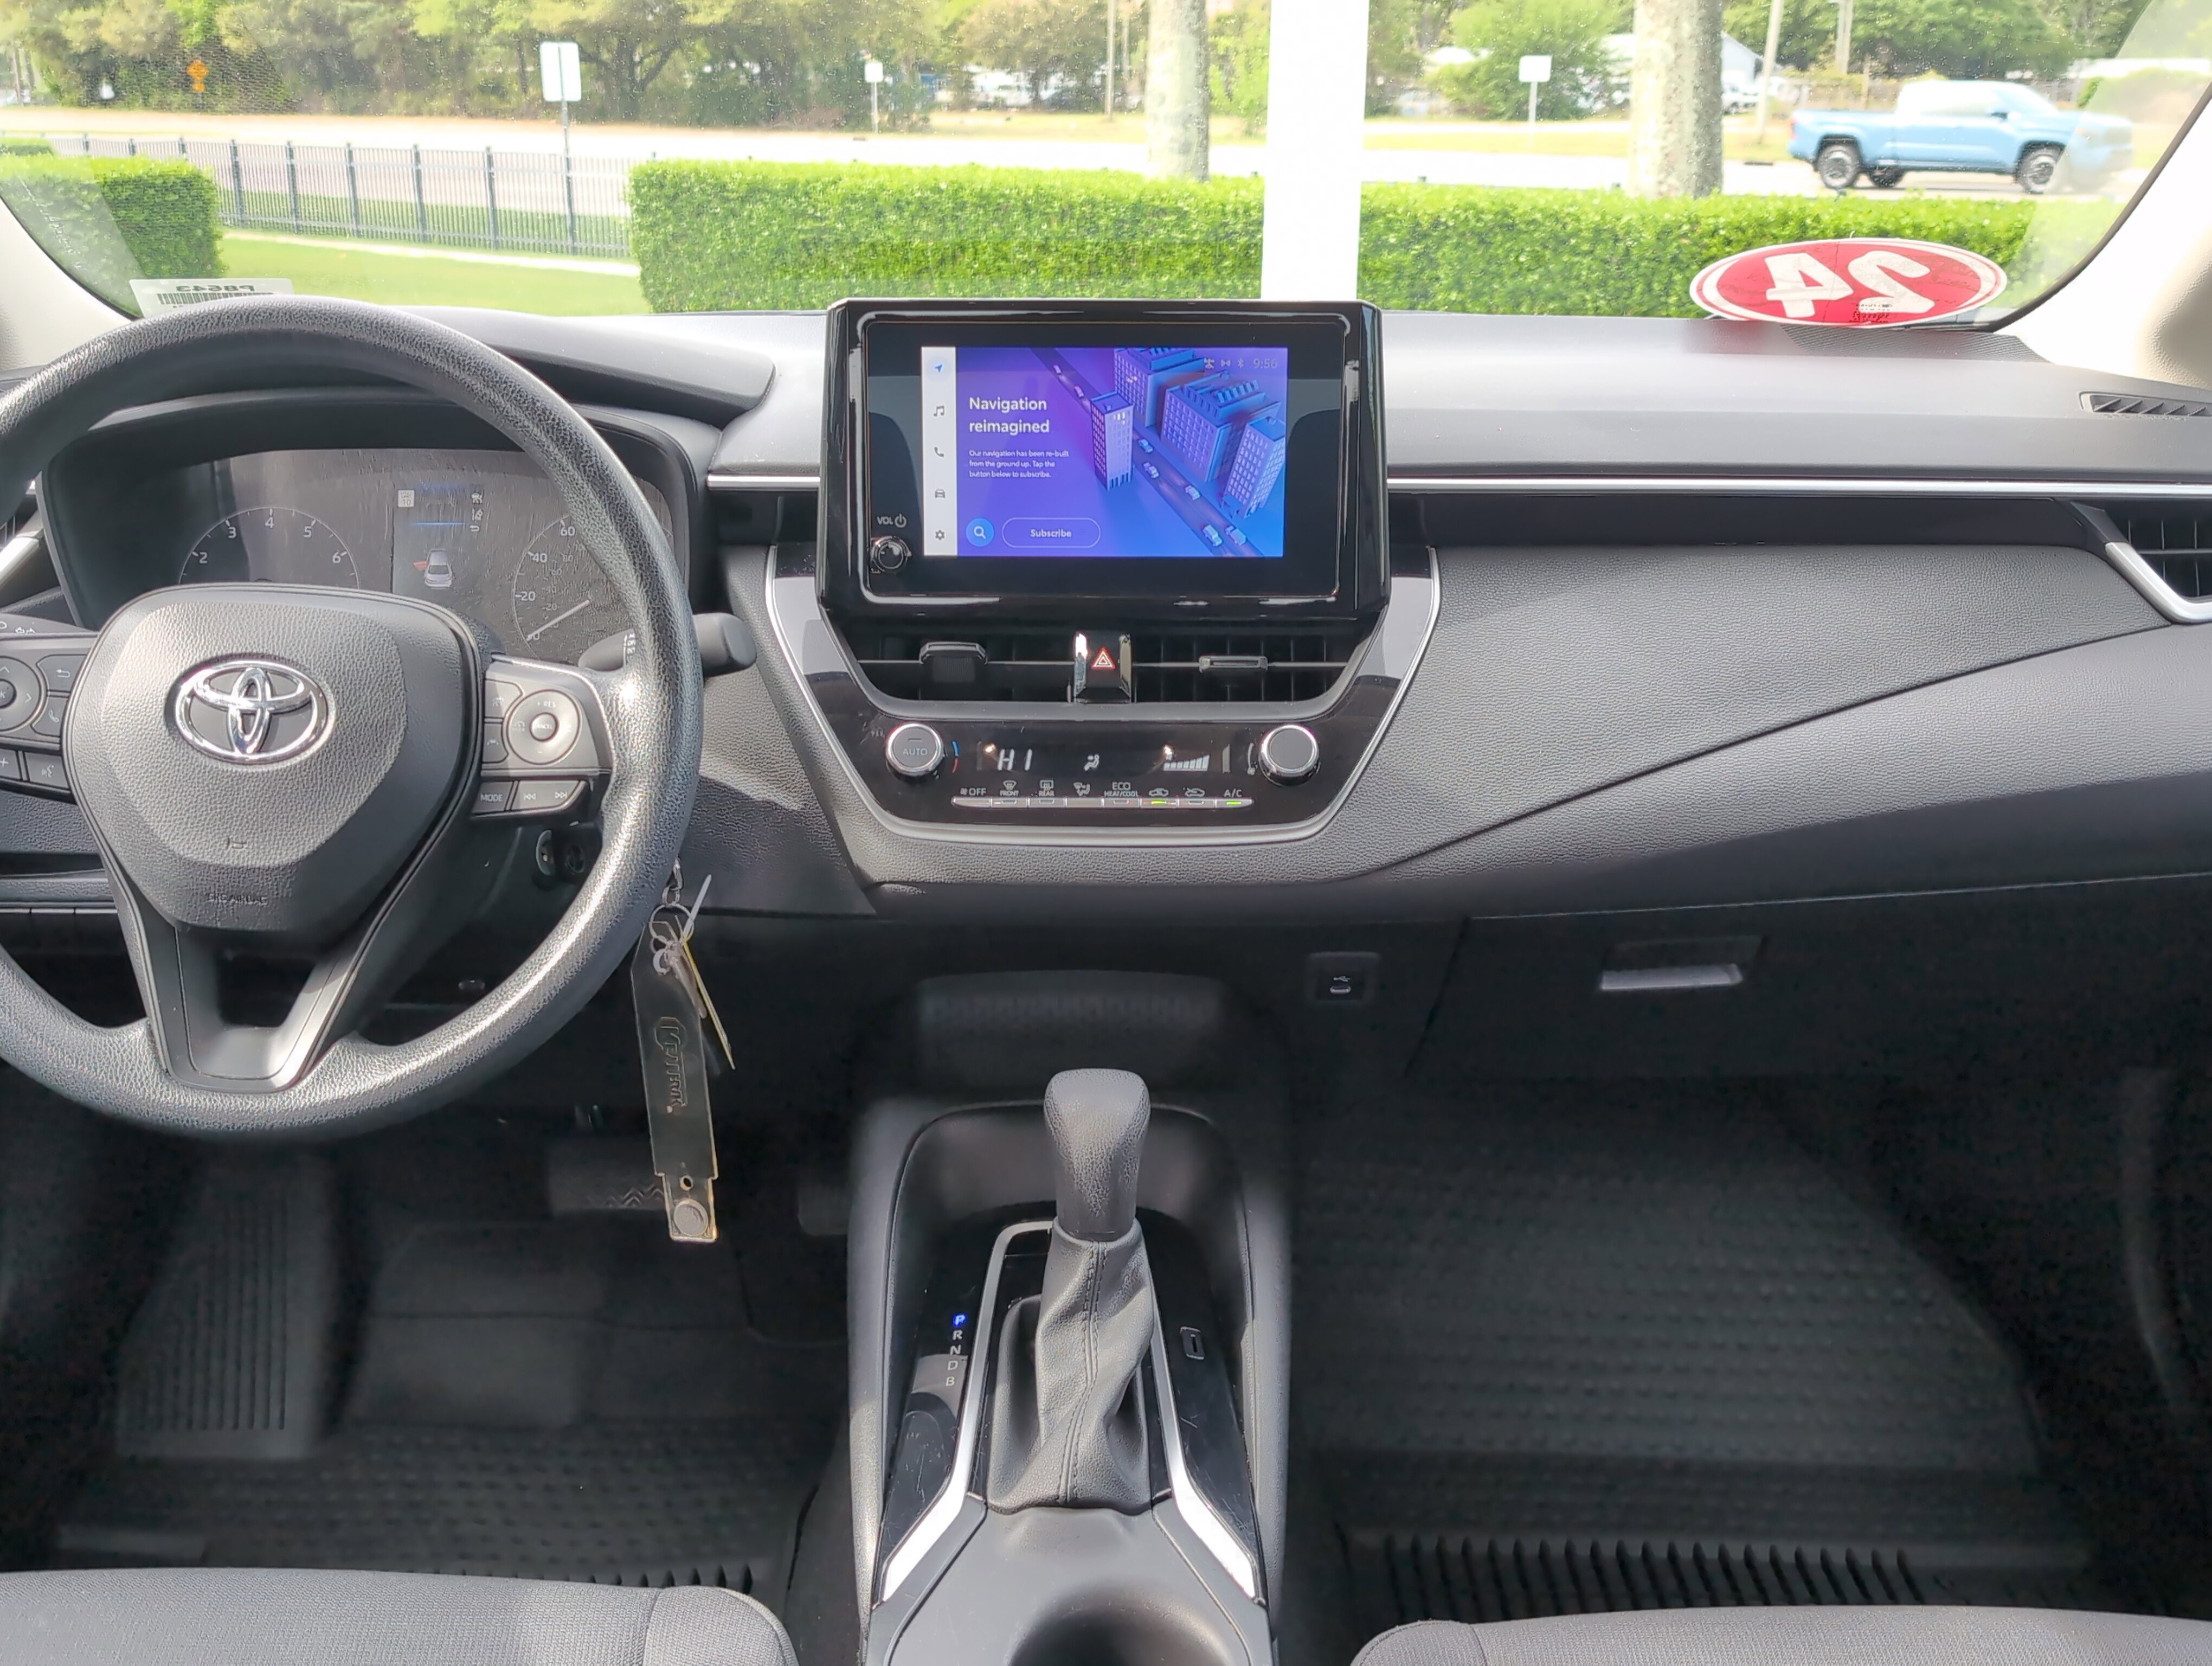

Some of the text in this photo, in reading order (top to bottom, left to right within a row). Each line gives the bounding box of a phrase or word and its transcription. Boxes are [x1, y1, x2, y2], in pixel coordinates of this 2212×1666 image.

[1253, 358, 1278, 369] 9:56
[969, 396, 1047, 413] Navigation
[969, 419, 1050, 435] reimagined
[265, 517, 274, 528] 4
[877, 516, 893, 525] VOL
[228, 527, 236, 539] 3
[303, 526, 312, 538] 5
[561, 526, 575, 536] 60
[1030, 529, 1071, 538] Subscribe
[199, 552, 208, 563] 2
[332, 552, 341, 563] 6
[532, 553, 548, 562] 40
[521, 591, 536, 601] 20
[998, 749, 1032, 771] HI
[480, 793, 503, 803] MODE
[1224, 789, 1242, 797] A/C
[954, 1314, 966, 1326] P
[953, 1330, 963, 1340] R
[950, 1344, 961, 1355] N
[947, 1361, 958, 1370] D
[946, 1376, 955, 1386] B
